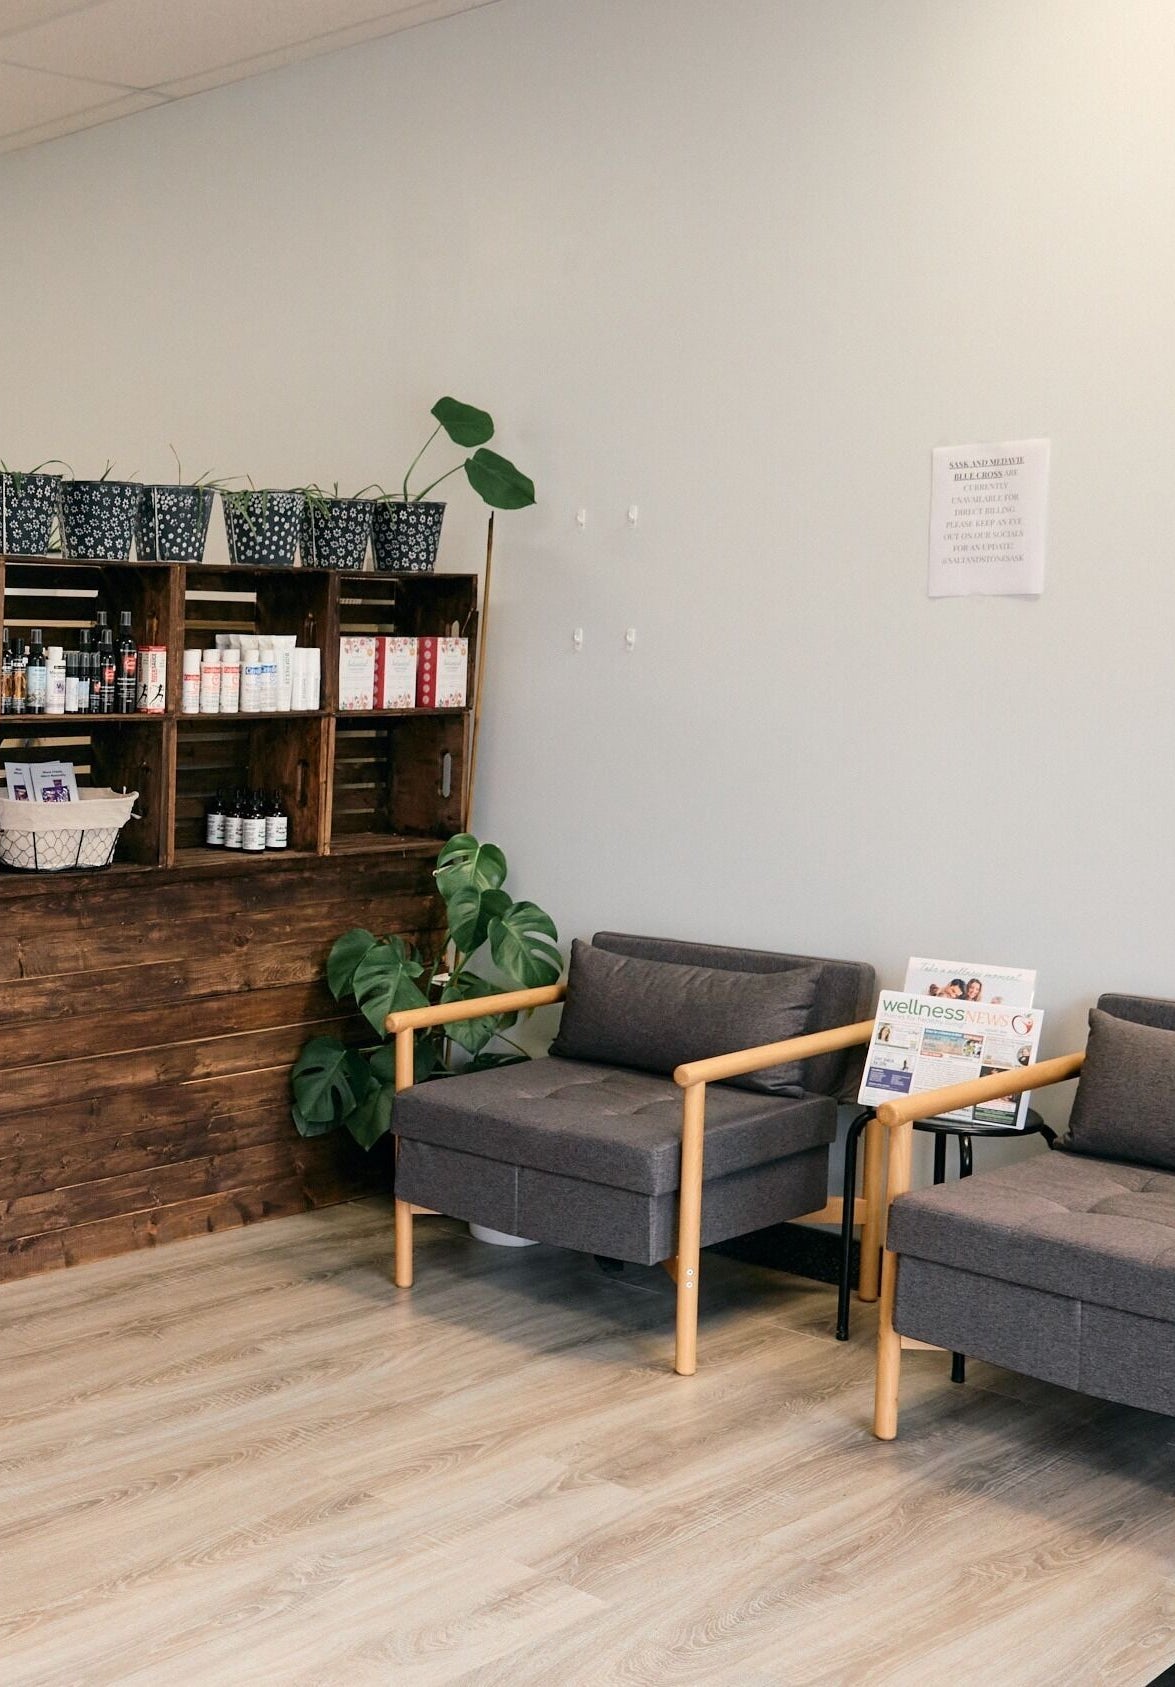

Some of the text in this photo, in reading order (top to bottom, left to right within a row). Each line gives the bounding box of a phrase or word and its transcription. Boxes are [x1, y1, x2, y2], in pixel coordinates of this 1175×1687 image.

[949, 461, 969, 470] SASK
[972, 459, 988, 467] AND
[954, 469, 1018, 481] BLUE CROSS ARE
[963, 482, 1008, 491] CURRENTLY
[951, 494, 1019, 504] UNAVAILABLE FOR
[954, 508, 982, 516] DIRECT
[945, 520, 972, 528] PLEASE
[975, 518, 995, 527] KEEP
[953, 544, 968, 552] FOR
